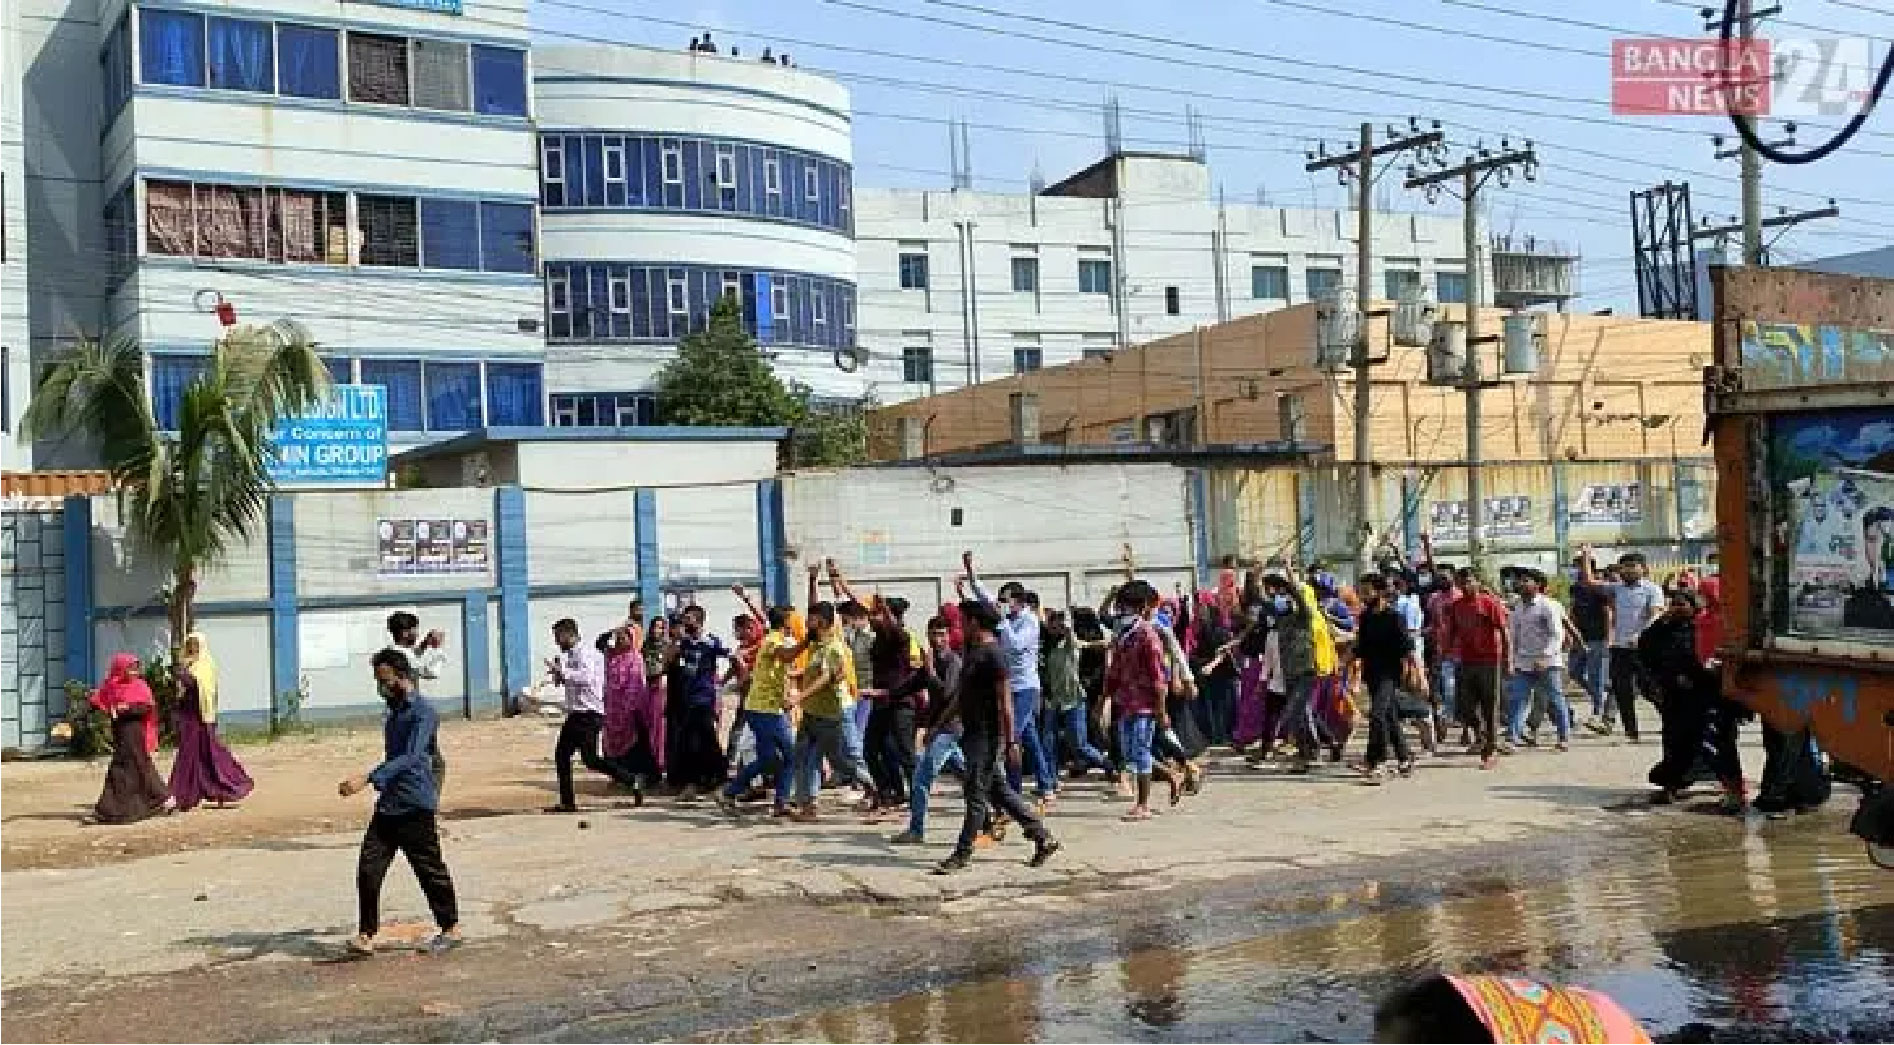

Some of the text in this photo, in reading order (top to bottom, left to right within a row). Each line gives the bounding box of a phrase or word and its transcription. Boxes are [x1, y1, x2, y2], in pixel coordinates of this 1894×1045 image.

[290, 390, 347, 419] ESIGN
[365, 427, 381, 440] of
[315, 444, 383, 463] GROUP
